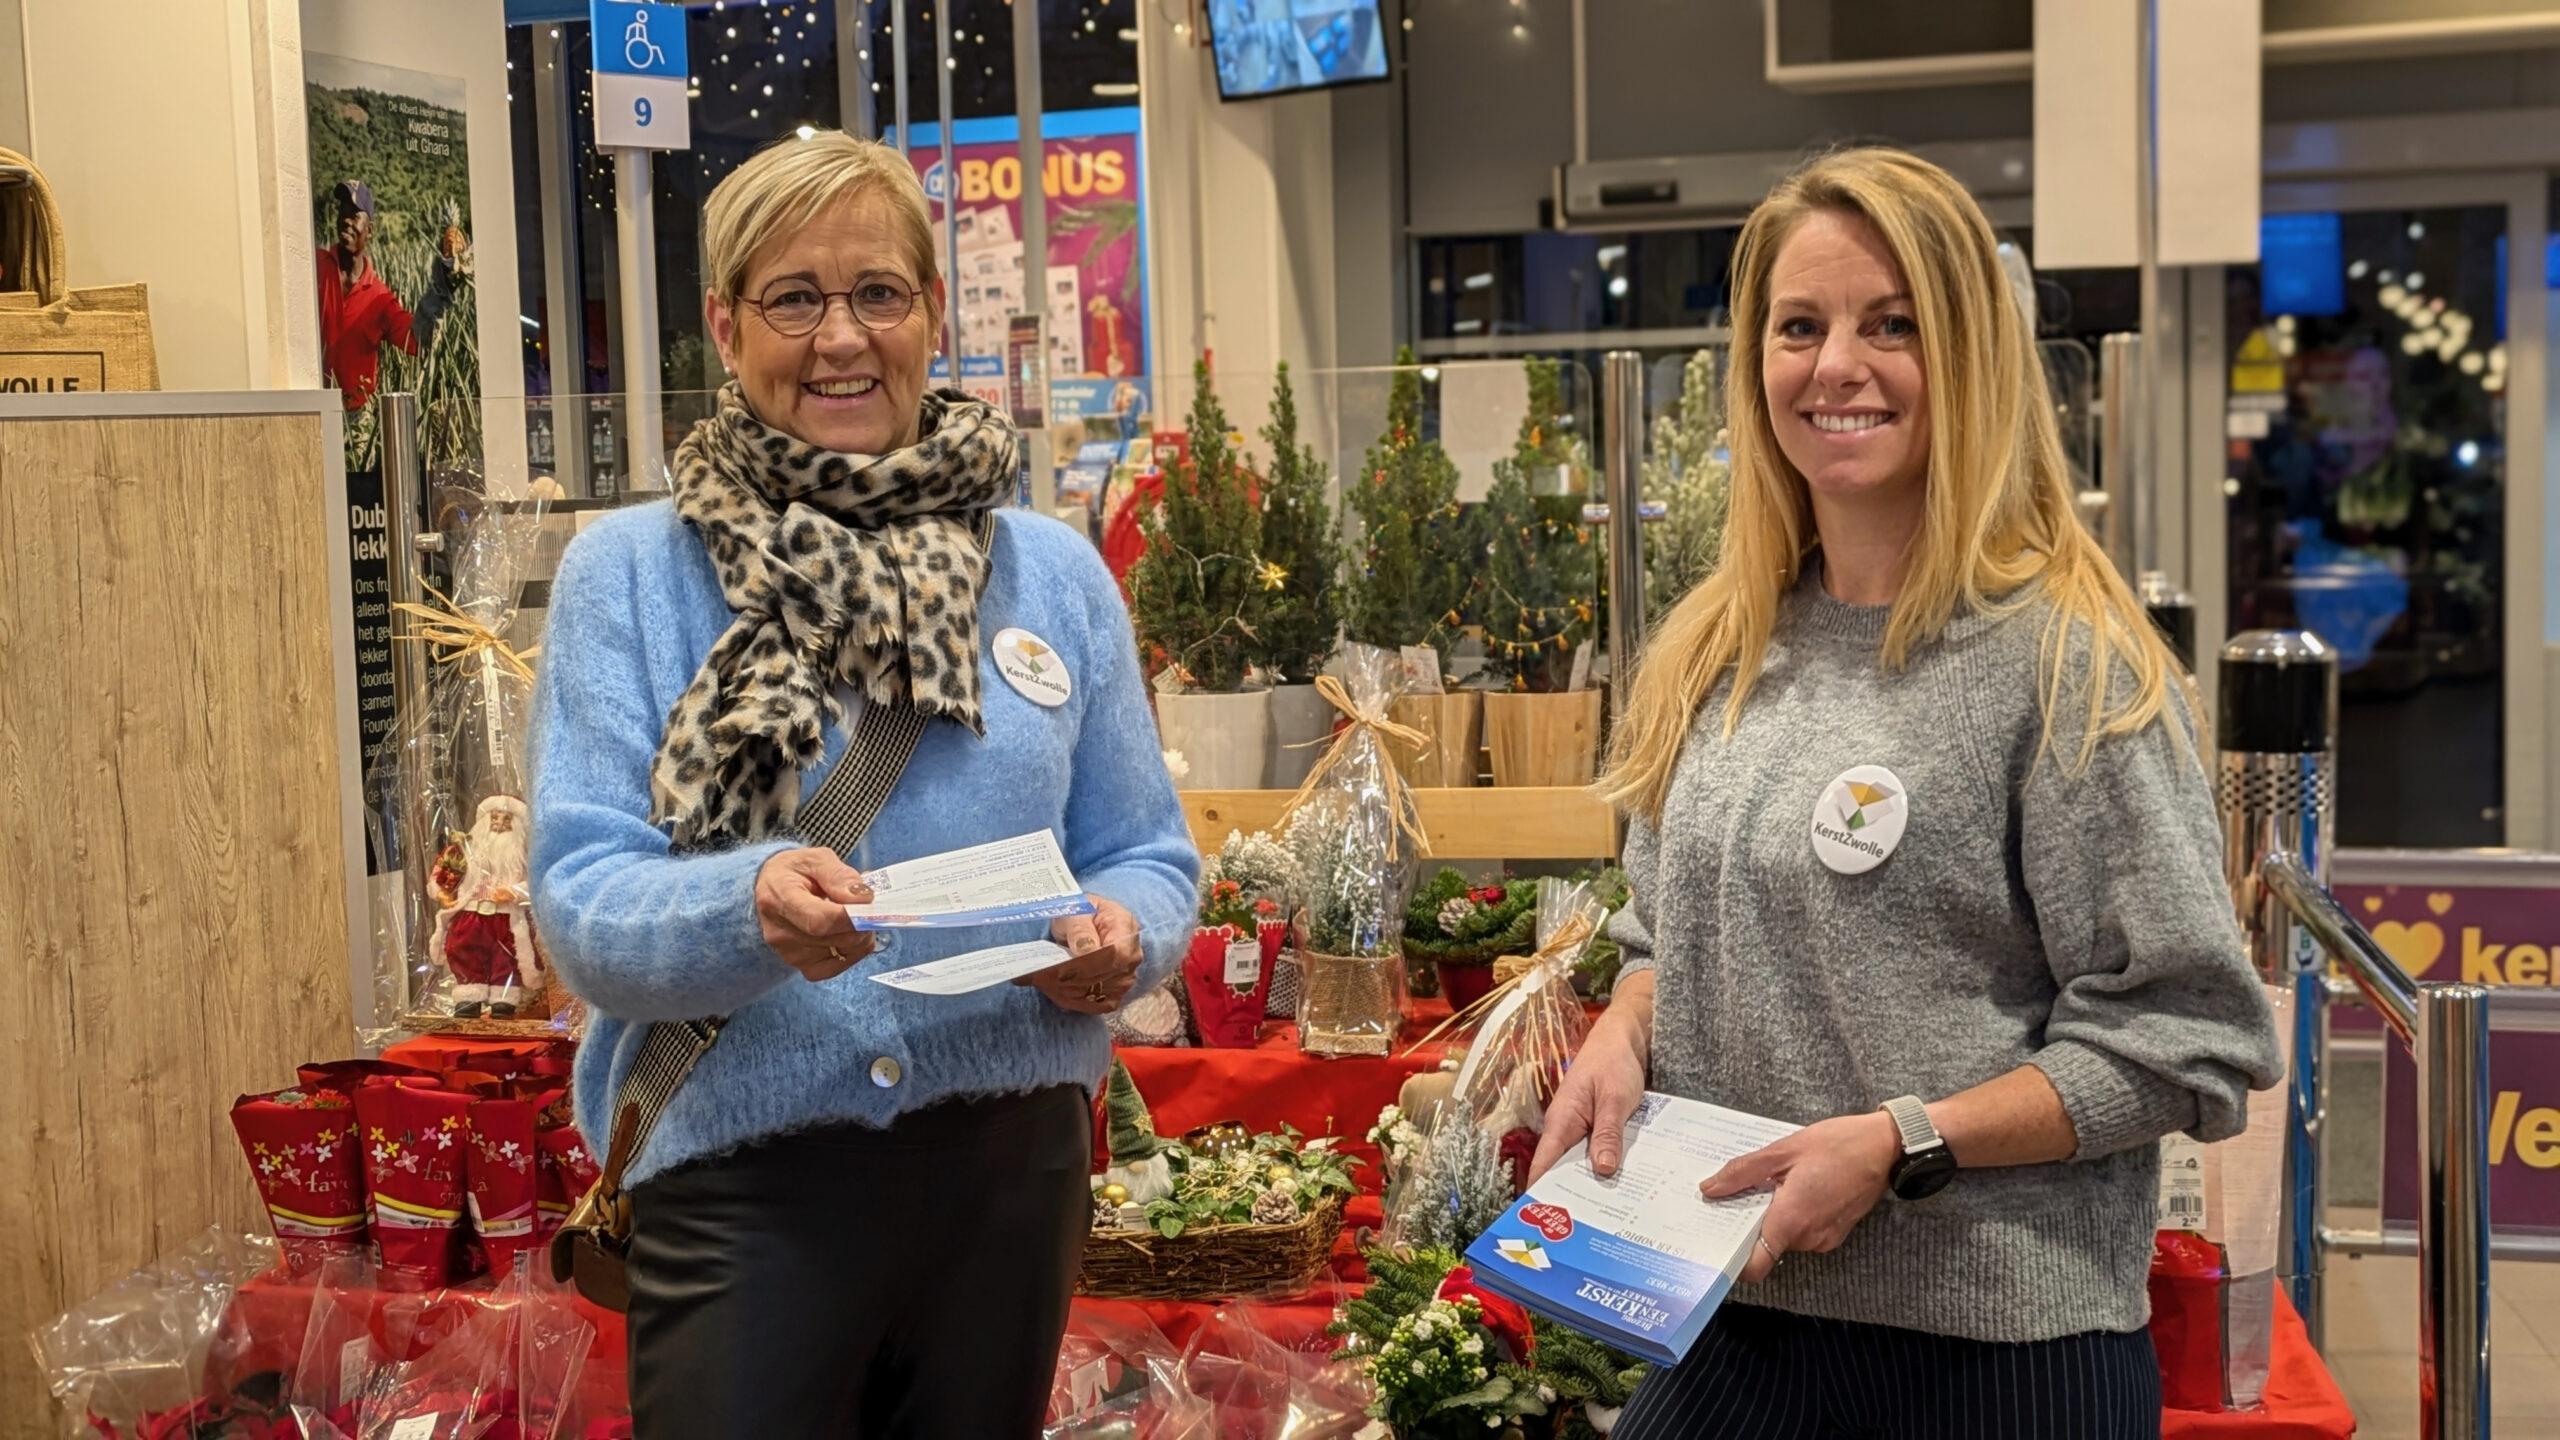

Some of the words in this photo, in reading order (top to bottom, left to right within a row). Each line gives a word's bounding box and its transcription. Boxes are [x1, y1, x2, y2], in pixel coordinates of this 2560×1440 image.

[634, 97, 652, 127] 9
[408, 118, 449, 138] Kwabena
[405, 137, 419, 153] uit
[420, 138, 450, 157] Ghana
[960, 150, 1126, 202] BONUS
[351, 502, 385, 529] Dub
[353, 533, 388, 560] lekk
[355, 578, 375, 594] Ons
[356, 601, 385, 618] alleen
[357, 625, 375, 641] het
[359, 647, 389, 664] lekker
[361, 695, 394, 711] samen
[1813, 821, 1885, 859] KerstZwolle
[1527, 1203, 1546, 1219] EEN
[1541, 1204, 1568, 1223] GIFT!
[1542, 1218, 1569, 1235] GEEF
[1614, 1228, 1657, 1248] NODIG?
[1657, 1241, 1672, 1252] ER
[1575, 1283, 1642, 1317] KERST
[1621, 1289, 1658, 1307] PAKKET
[1640, 1305, 1670, 1323] EEN
